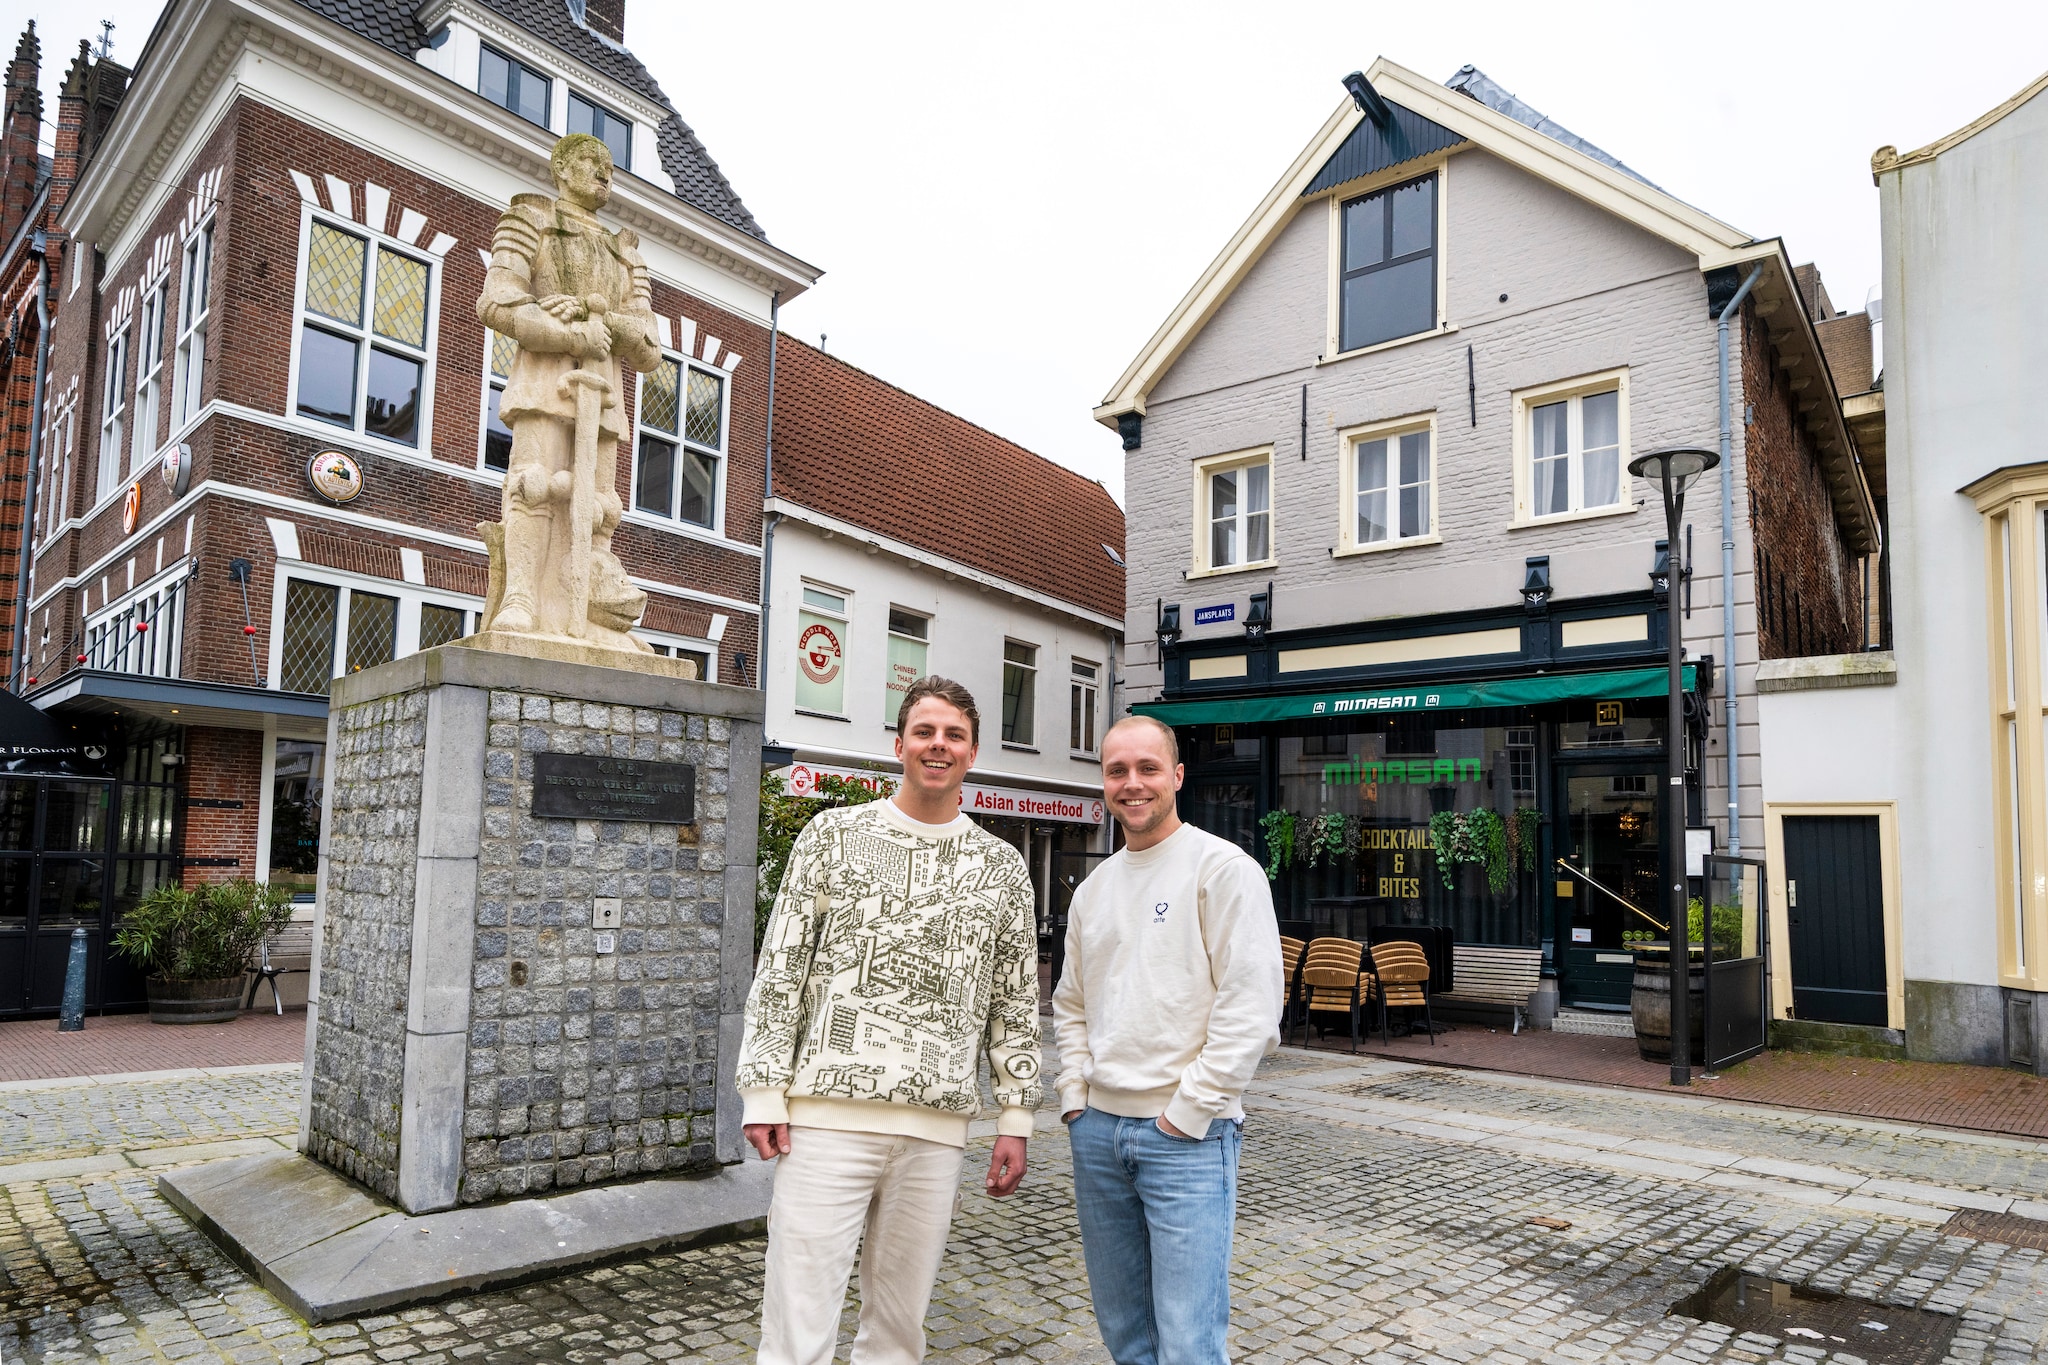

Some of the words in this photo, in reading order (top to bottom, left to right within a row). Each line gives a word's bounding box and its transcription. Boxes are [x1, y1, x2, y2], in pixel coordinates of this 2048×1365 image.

[1197, 608, 1232, 621] JANSPLAATS
[800, 626, 822, 649] NOODLE
[893, 663, 917, 676] CHINEES
[897, 674, 913, 684] THAIS
[596, 760, 644, 777] KAREL
[974, 790, 1014, 811] Asian
[1018, 797, 1083, 818] streetfood
[298, 839, 313, 847] BAR
[1394, 853, 1404, 874] &
[1379, 877, 1420, 898] BITES
